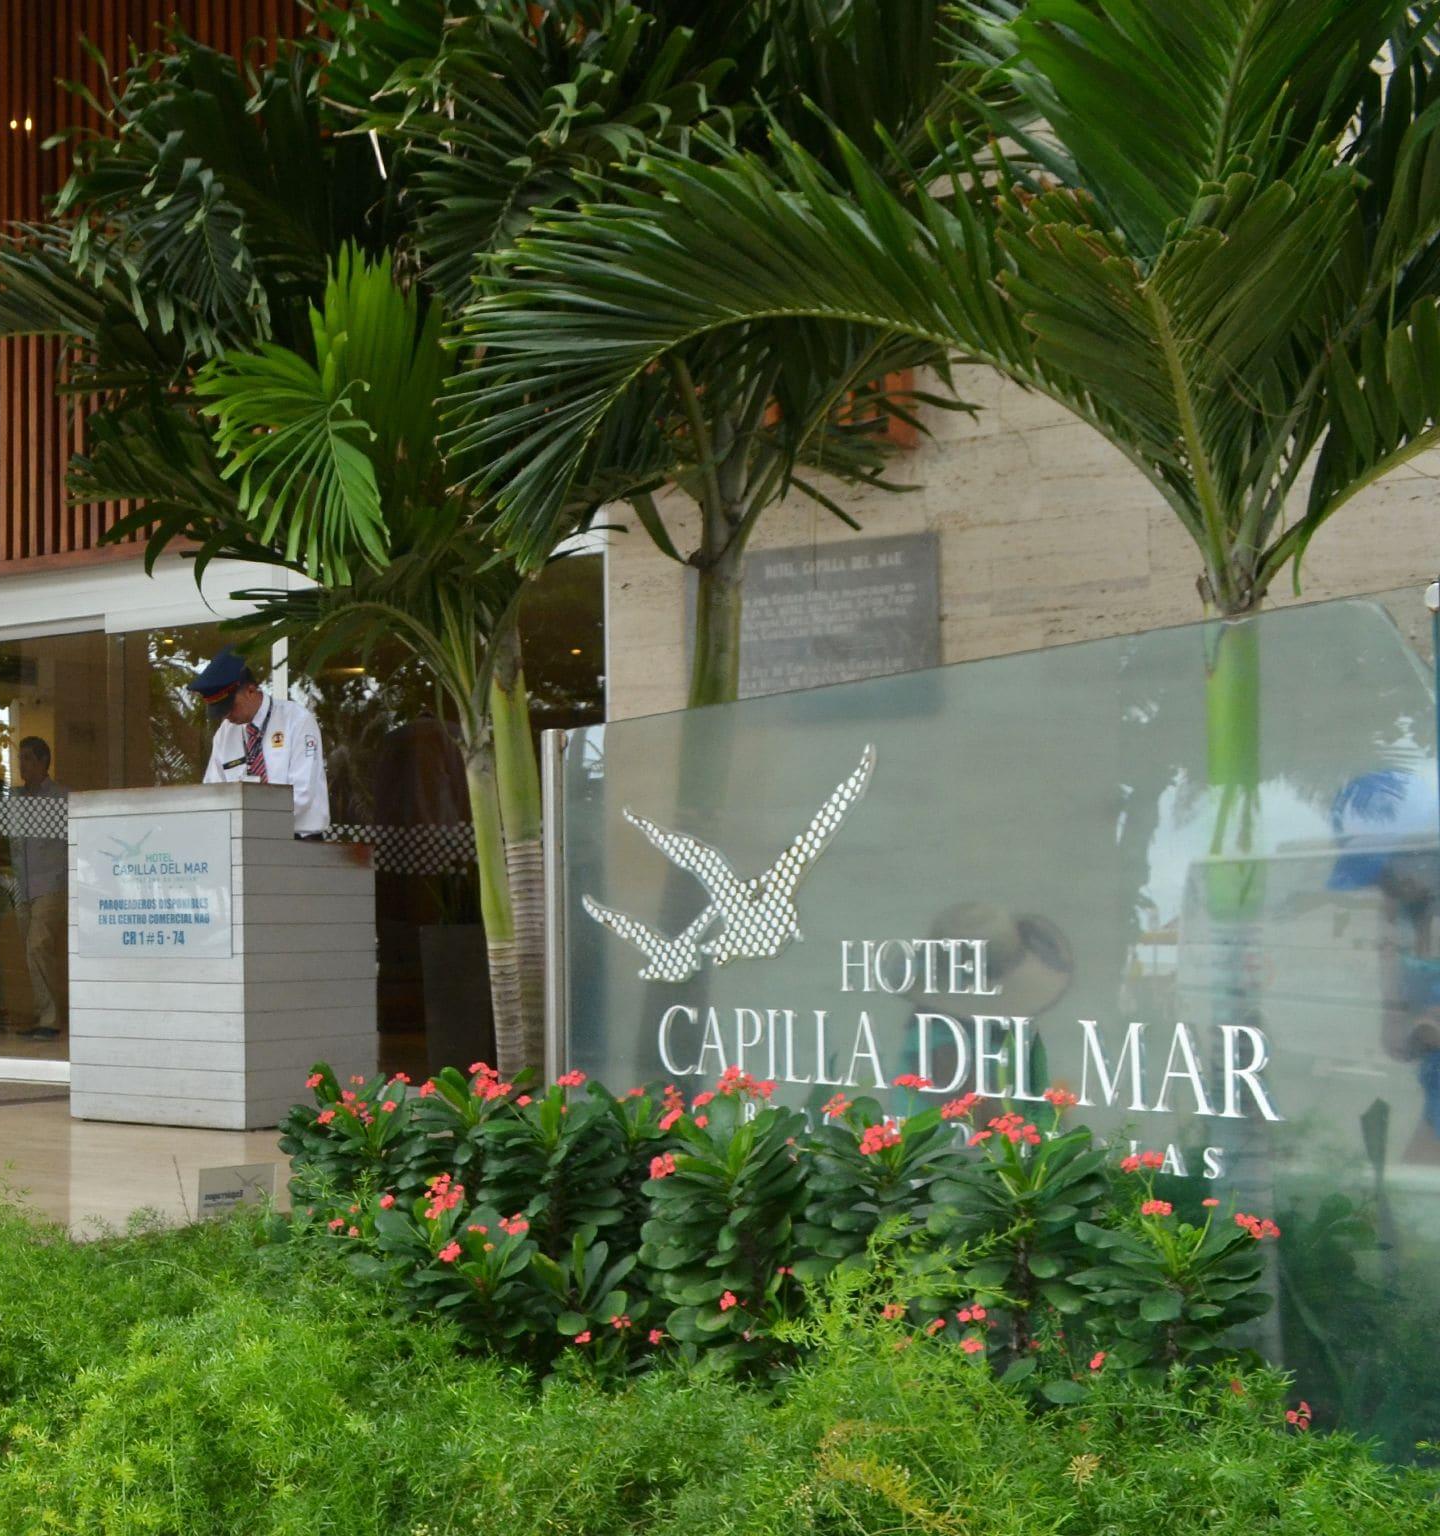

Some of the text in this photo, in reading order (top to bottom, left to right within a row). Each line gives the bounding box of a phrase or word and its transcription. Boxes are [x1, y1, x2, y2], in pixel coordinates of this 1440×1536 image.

[145, 853, 173, 863] HOTEL
[113, 862, 209, 876] CAPILLA DEL MAR
[99, 897, 208, 911] PARQUEADEROS DISPONIBLES
[98, 914, 108, 925] EN
[109, 914, 116, 925] EL
[118, 914, 147, 925] CENTRO
[148, 913, 192, 924] COMERCIAL
[123, 931, 136, 945] CR
[138, 931, 145, 945] 1
[157, 930, 164, 945] 5
[172, 930, 185, 945] 74
[840, 938, 1002, 996] HOTEL
[658, 1004, 1286, 1122] CAPILLA DEL MAR
